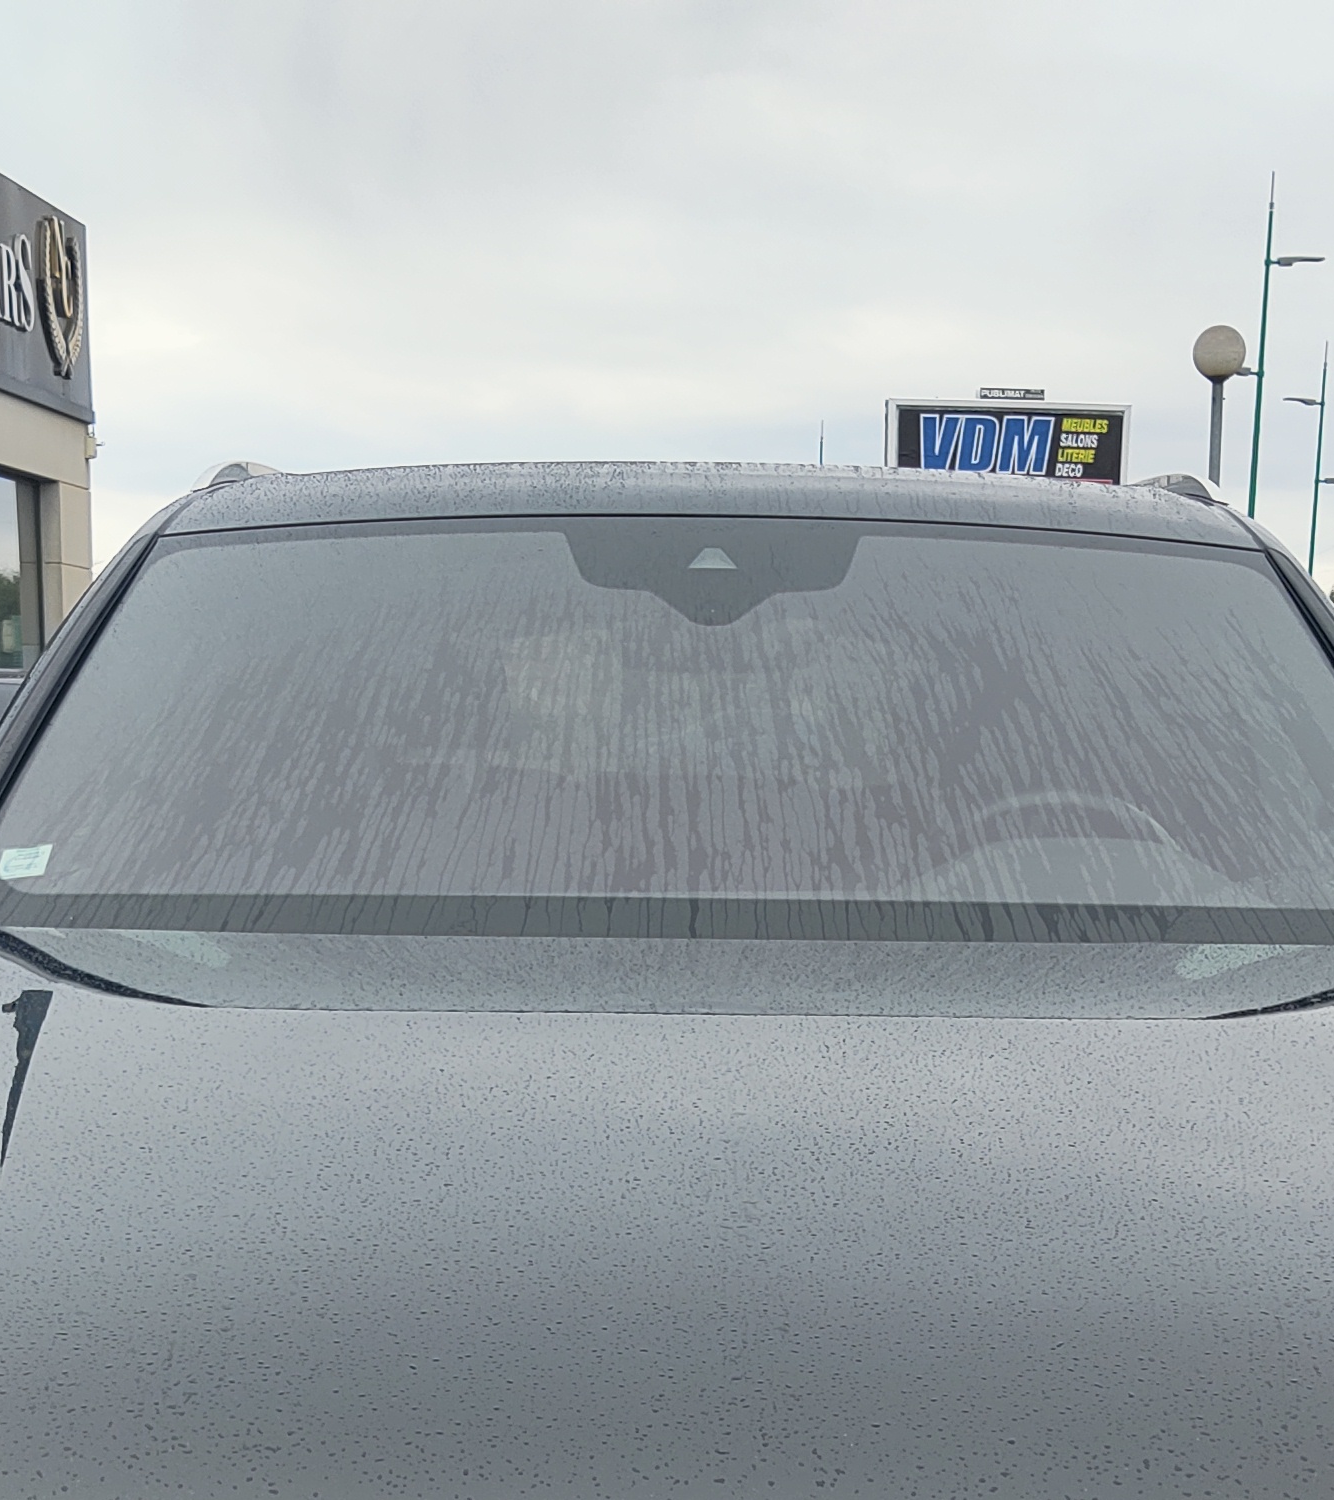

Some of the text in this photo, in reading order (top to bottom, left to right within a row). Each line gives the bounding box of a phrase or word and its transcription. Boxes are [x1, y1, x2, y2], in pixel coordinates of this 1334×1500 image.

[1061, 418, 1109, 433] MEUBLES
[920, 413, 1055, 475] VDM
[1059, 433, 1098, 448] SALONS
[1057, 448, 1095, 463] LITERIE
[1055, 463, 1083, 477] DECO
